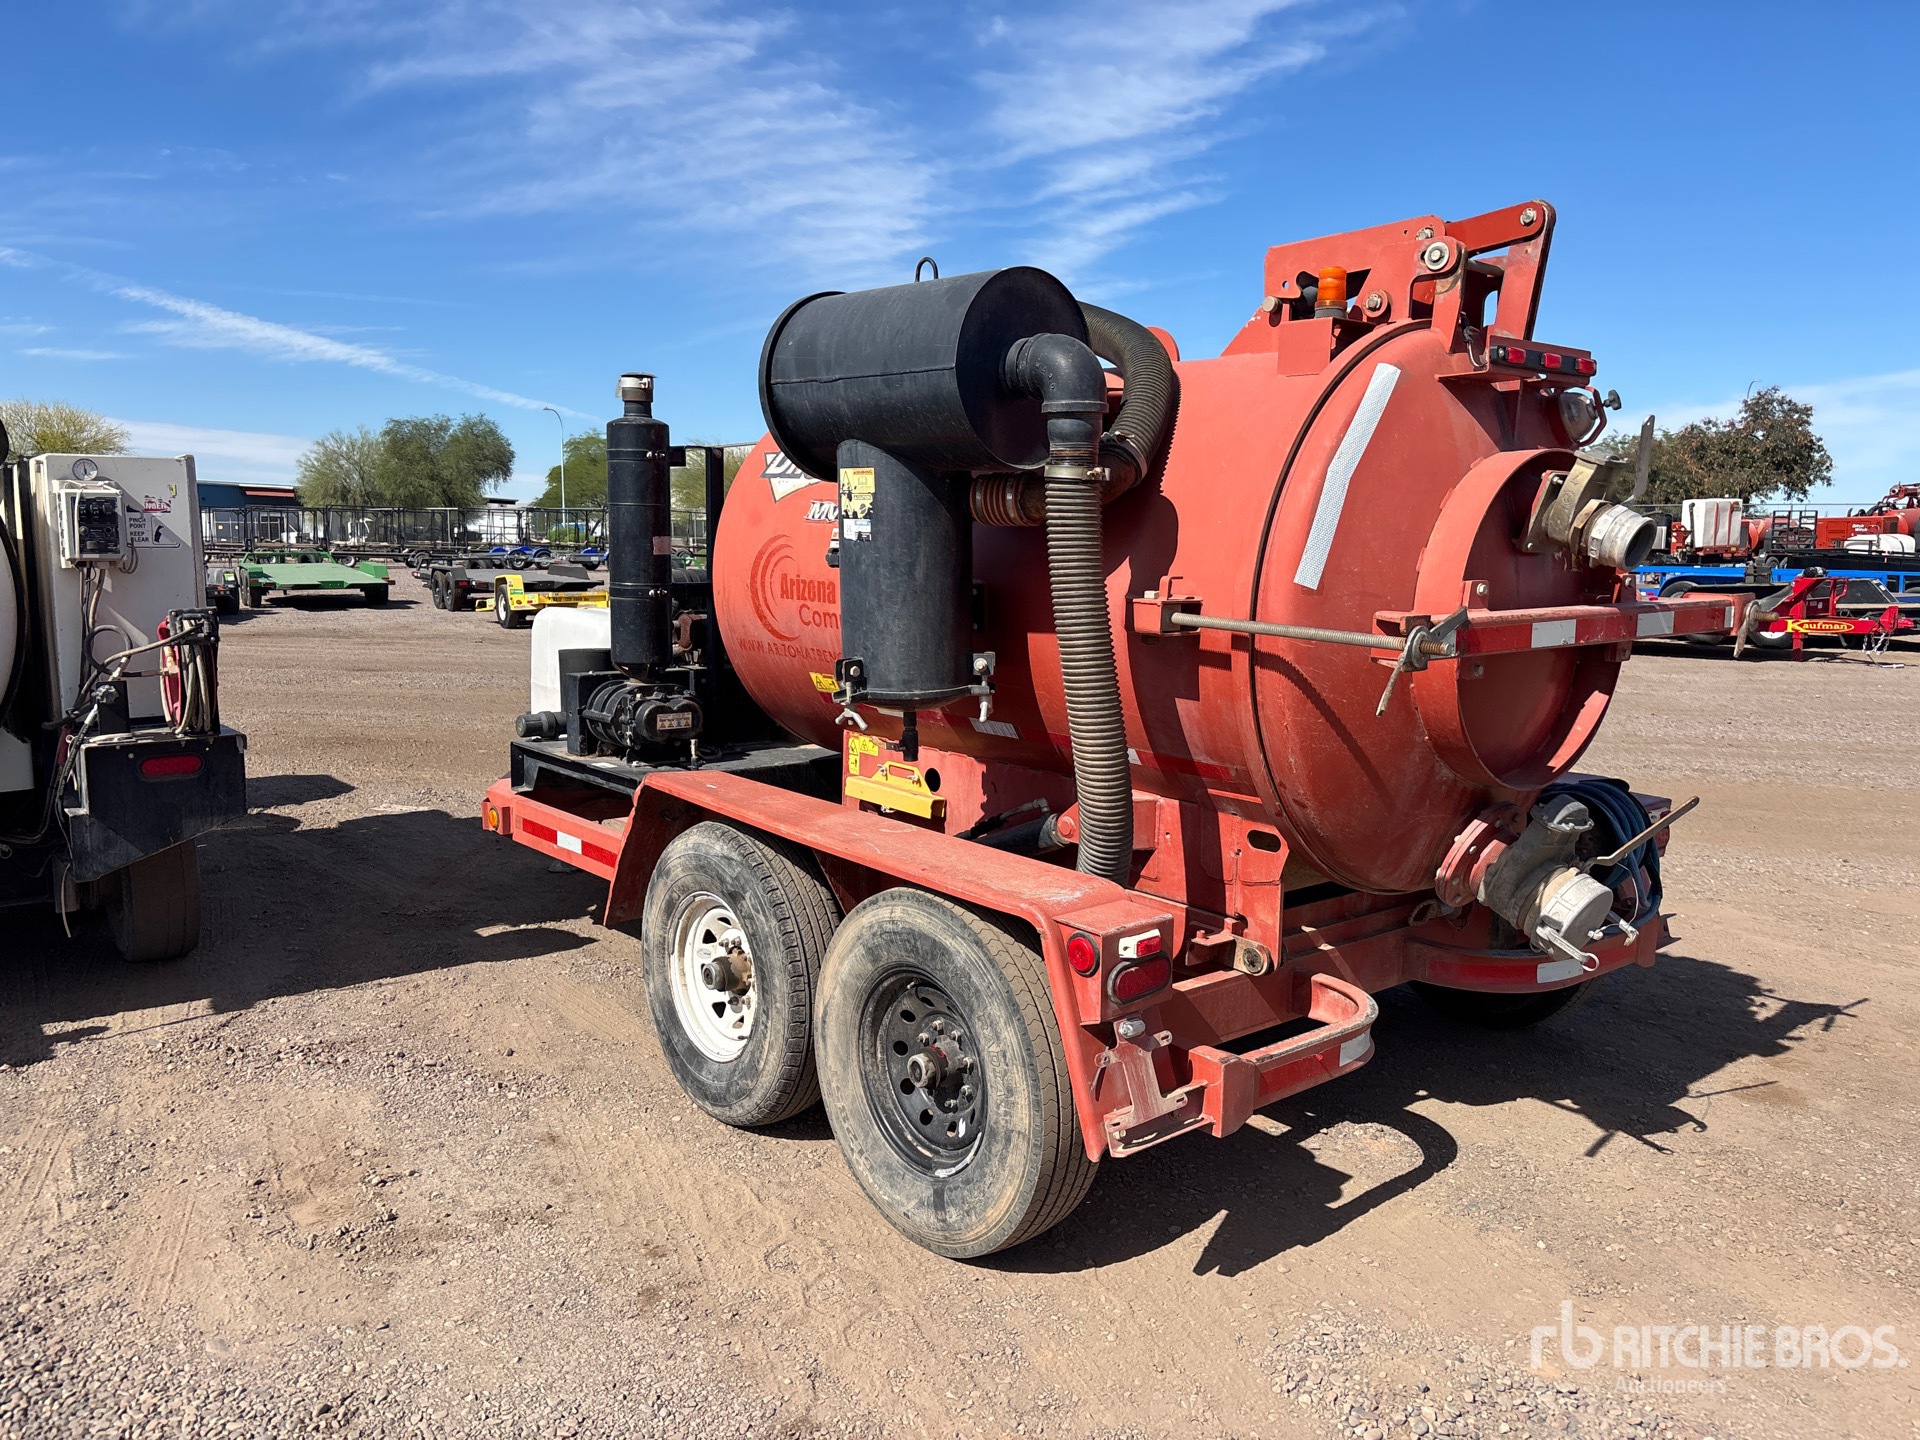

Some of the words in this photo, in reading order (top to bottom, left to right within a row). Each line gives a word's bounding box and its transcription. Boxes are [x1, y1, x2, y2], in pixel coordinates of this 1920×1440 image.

[780, 573, 836, 604] Arizona
[799, 603, 842, 630] Com
[1785, 619, 1848, 633] Kaufman
